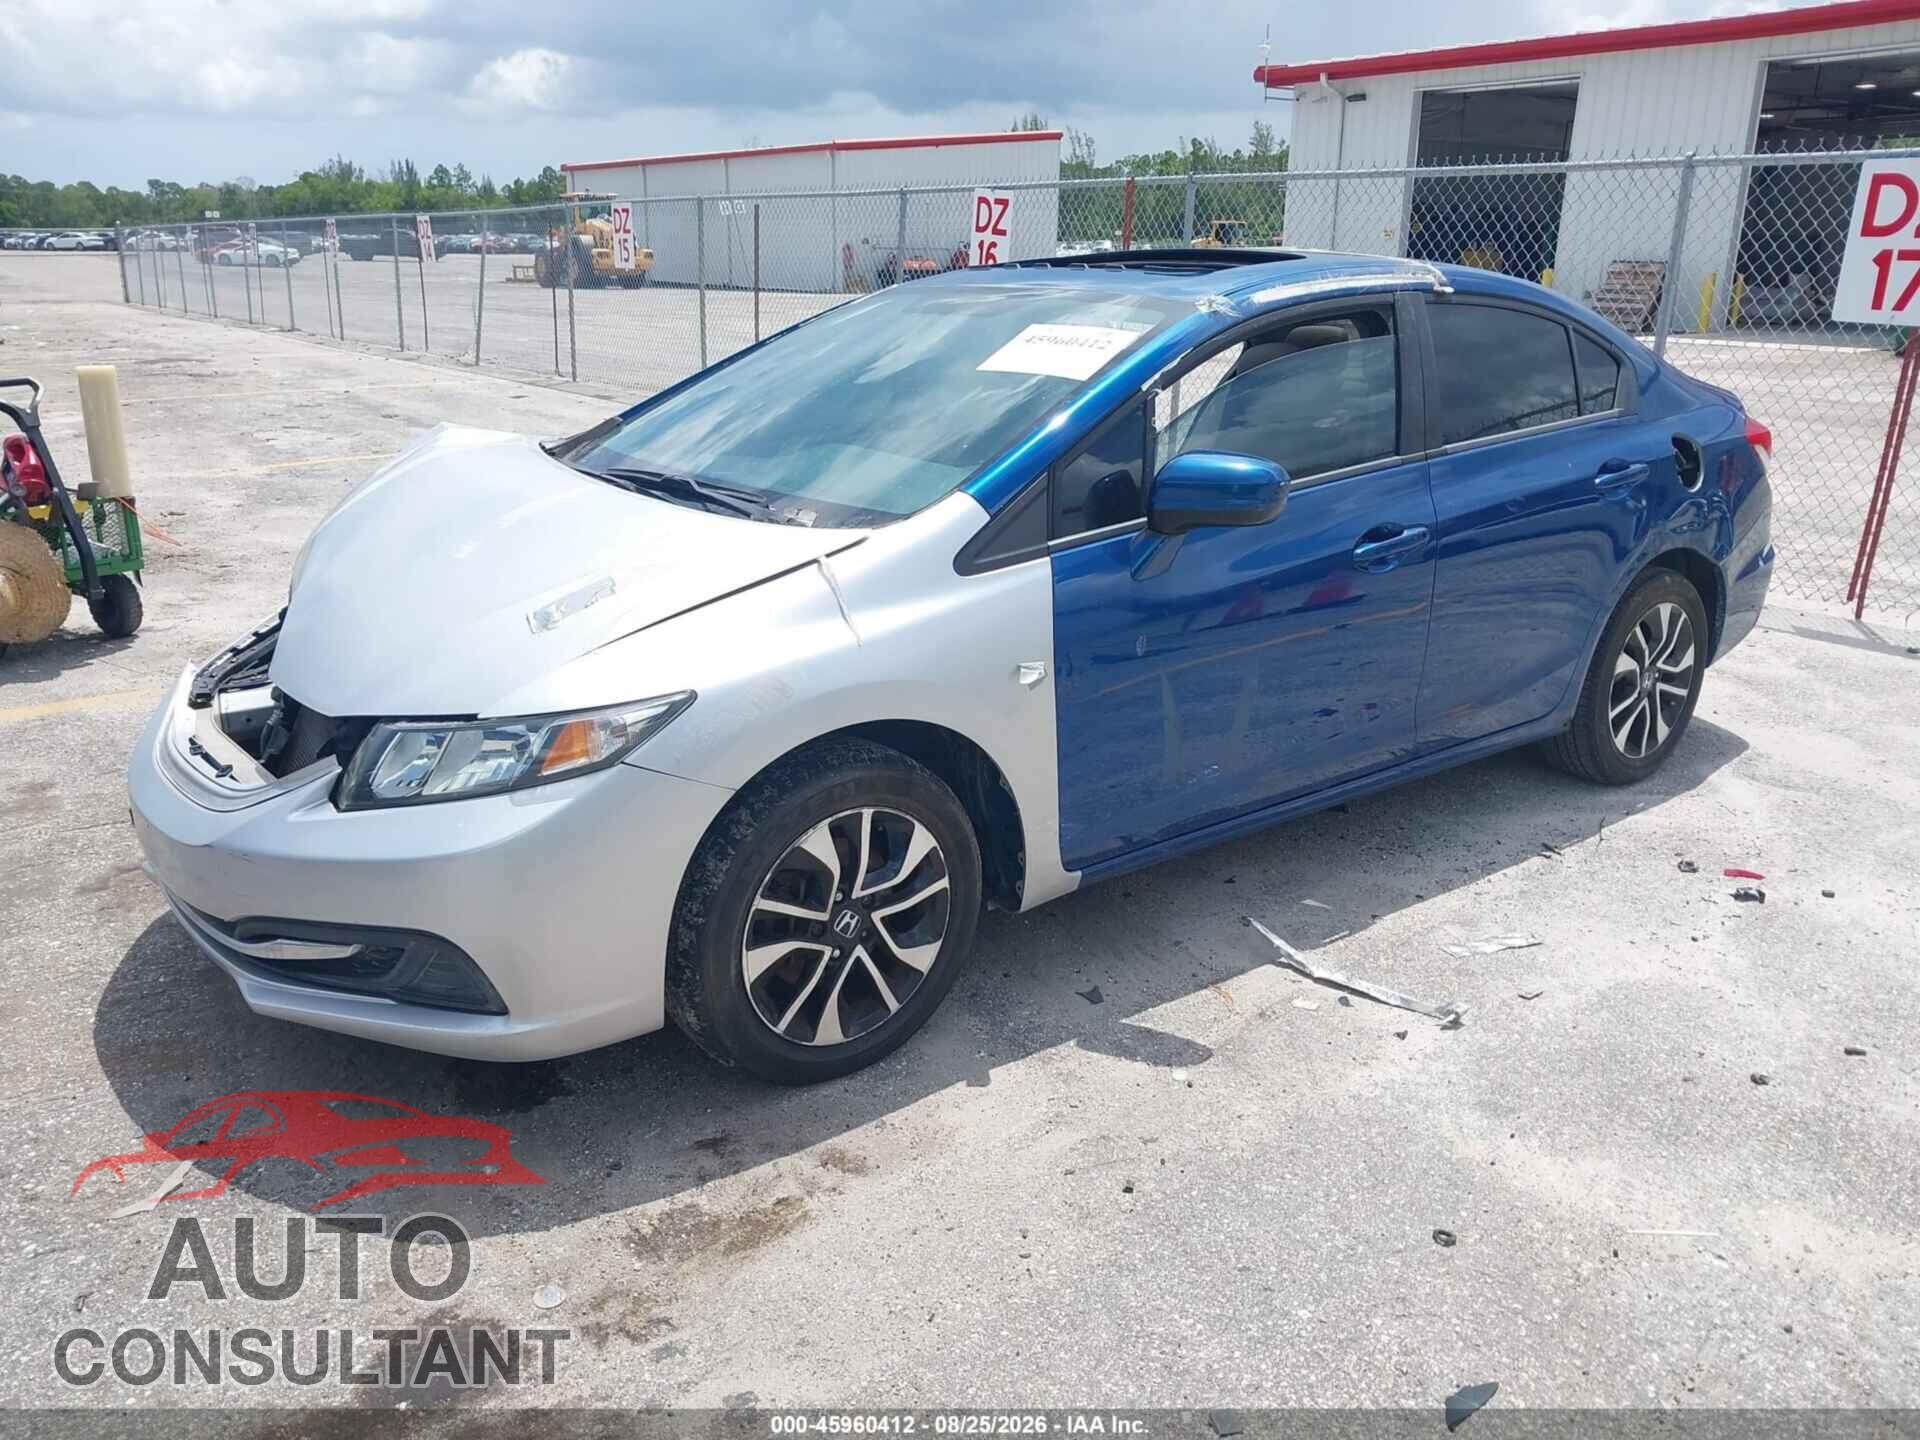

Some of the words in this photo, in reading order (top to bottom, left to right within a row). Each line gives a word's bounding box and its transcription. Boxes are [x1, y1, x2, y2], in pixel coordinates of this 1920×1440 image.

[974, 196, 1009, 236] DZ
[1860, 172, 1920, 239] D
[613, 207, 632, 234] DZ
[618, 237, 631, 263] 15
[977, 240, 998, 265] 16
